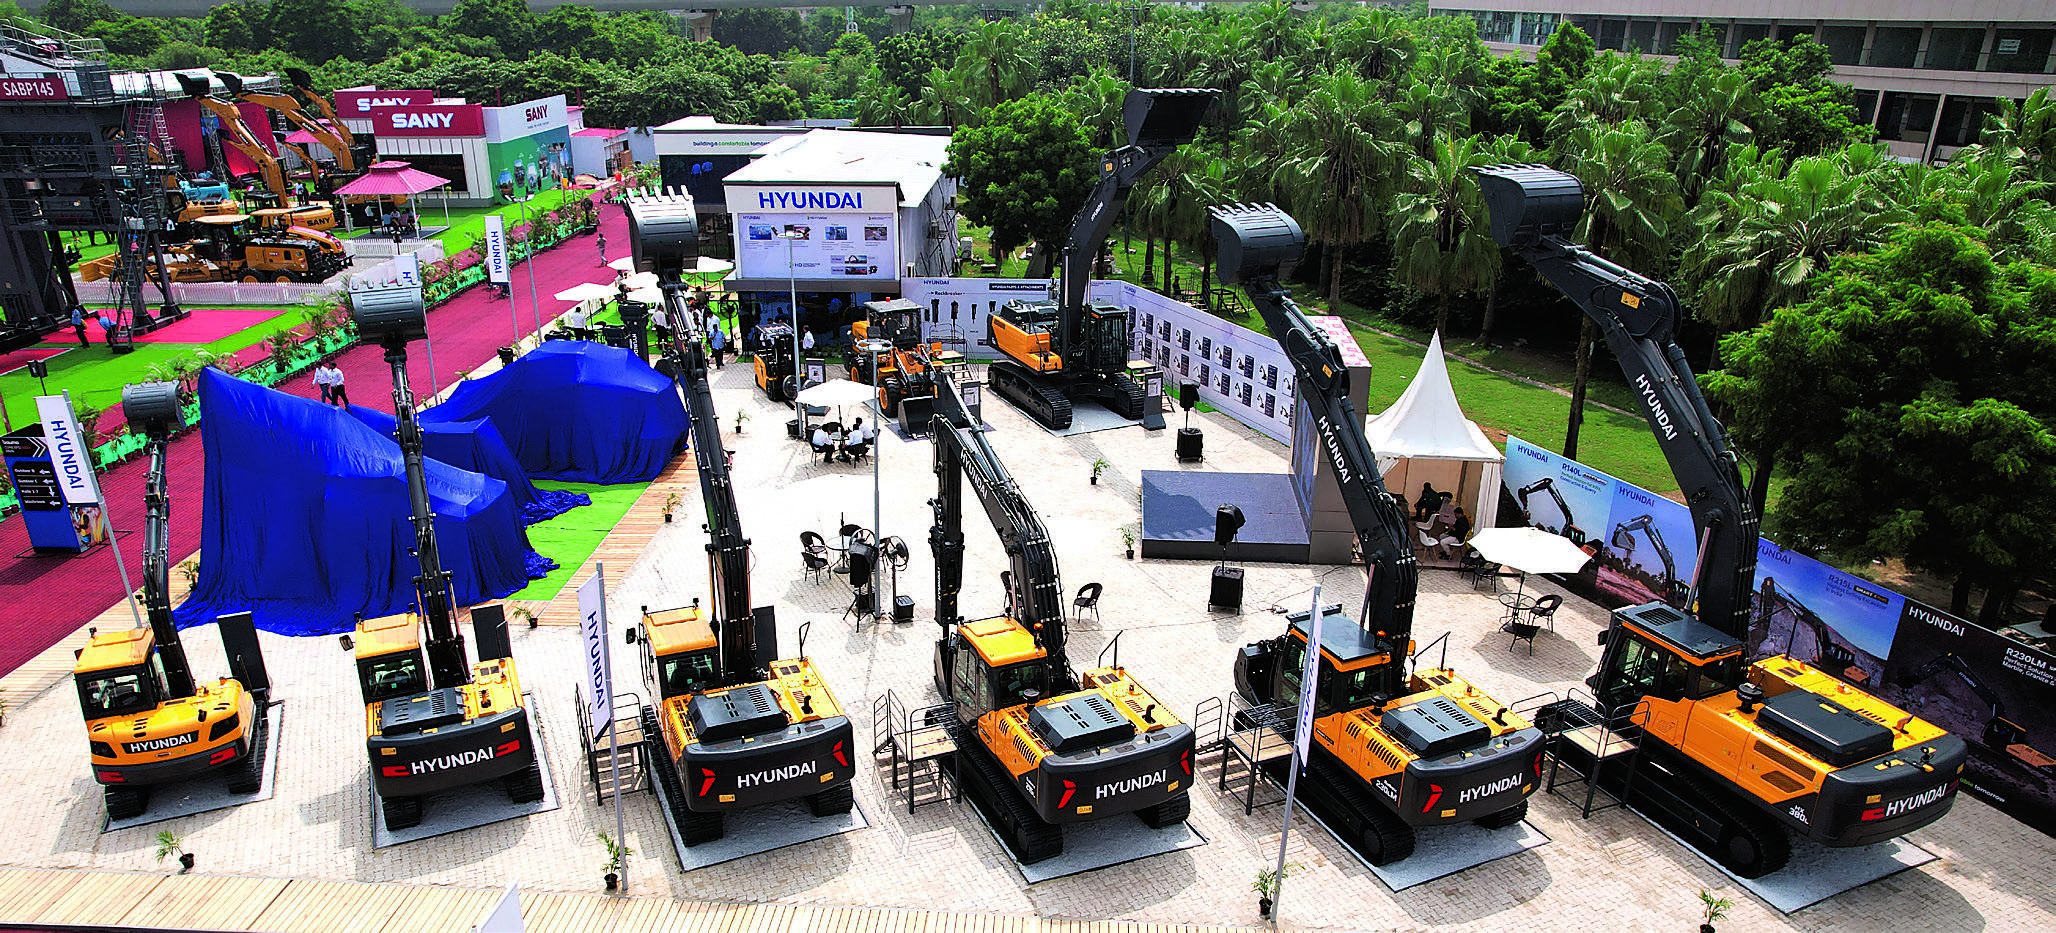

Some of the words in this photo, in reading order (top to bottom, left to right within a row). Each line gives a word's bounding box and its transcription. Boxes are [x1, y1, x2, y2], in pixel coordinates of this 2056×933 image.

[2, 81, 54, 97] SABP145
[392, 112, 454, 129] SANY
[525, 104, 548, 122] SANY
[758, 191, 863, 209] HYUNDAI
[306, 217, 331, 227] SANY
[490, 230, 503, 274] HYUNDAI
[1635, 373, 1678, 441] HYUNDAI
[51, 420, 85, 489] HYUNDAI
[1317, 415, 1352, 485] HYUNDAI
[1517, 444, 1549, 463] HYUNDAI
[960, 449, 988, 500] HYUNDAI
[1561, 462, 1582, 477] R140L
[1619, 486, 1655, 507] HYUNDAI
[1758, 545, 1792, 565] UNDAI
[1855, 586, 1873, 597] SMART
[1908, 605, 1965, 637] HYUNDAI
[587, 610, 605, 710] HYUNDAI
[2004, 656, 2027, 669] Perfect
[2027, 665, 2054, 680] Solution
[2005, 647, 2047, 669] R230LM
[2002, 660, 2025, 675] Marble,
[2025, 670, 2049, 684] Granite
[130, 733, 192, 753] HYUNDAI
[411, 747, 494, 775] HYUNDAI
[737, 760, 816, 789] HYUNDAI
[1095, 769, 1167, 800] HYUNDAI
[1459, 772, 1523, 803] HYUNDAI
[1974, 784, 2006, 803] tomorrow
[1794, 804, 1805, 814] HX
[1885, 783, 1948, 817] HYUNDAI
